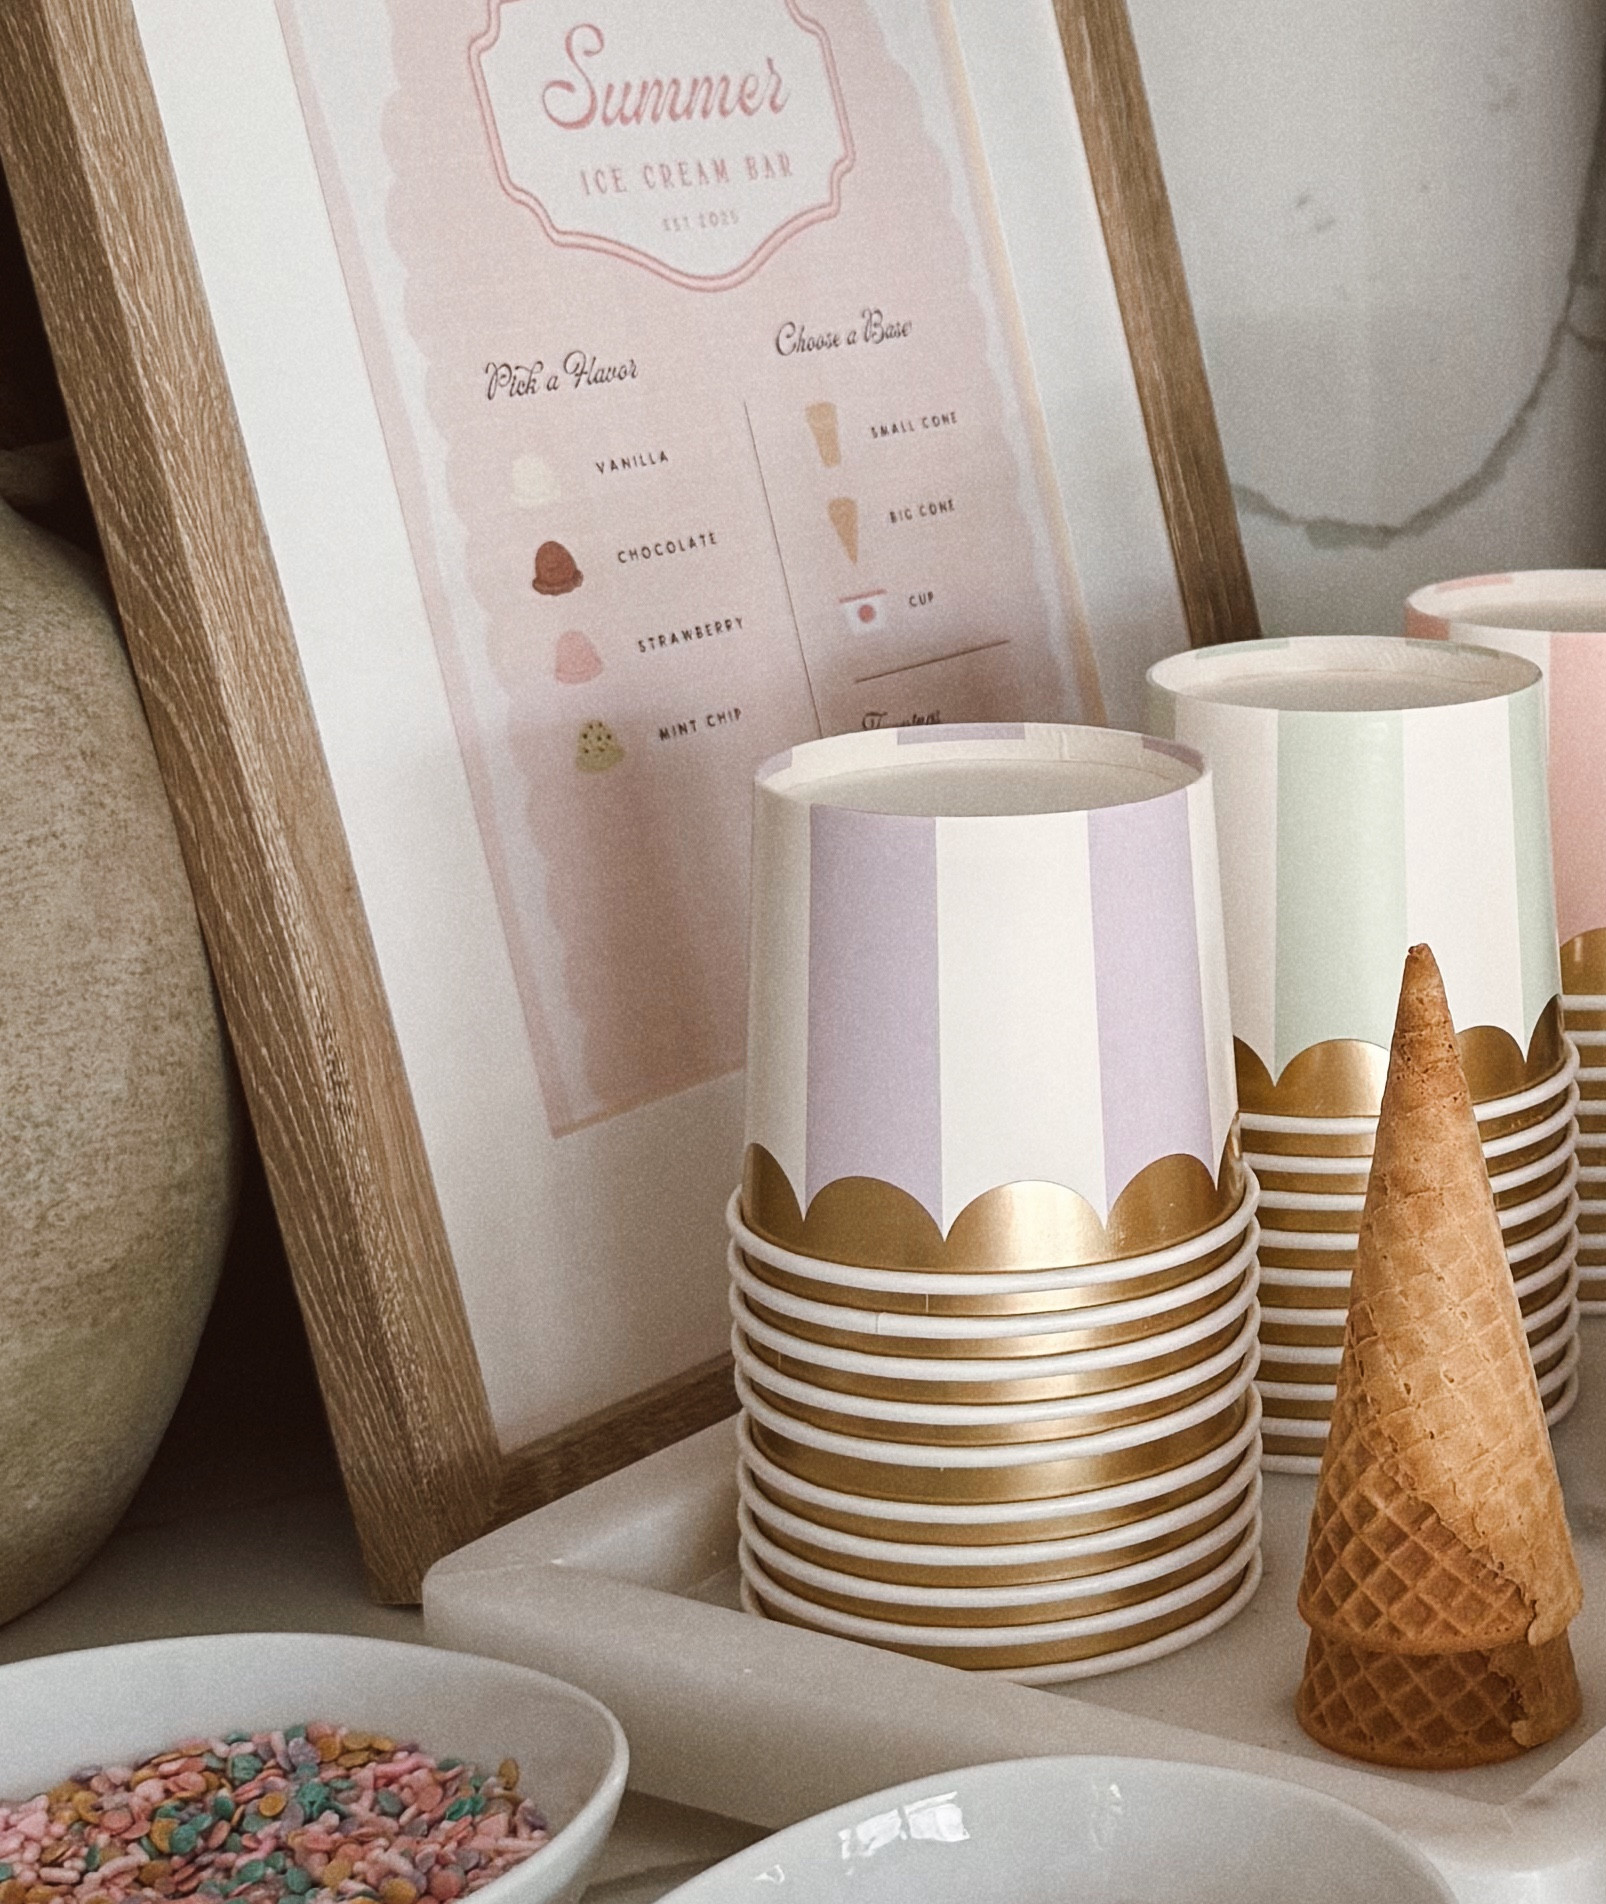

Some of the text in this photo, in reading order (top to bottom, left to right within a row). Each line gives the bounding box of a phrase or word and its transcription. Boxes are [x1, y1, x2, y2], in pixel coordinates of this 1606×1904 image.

[542, 23, 790, 130] Summer
[580, 151, 793, 195] ICE CREAM BAR
[775, 308, 913, 356] Choose a Base
[485, 350, 638, 400] Pick a Flavor
[870, 411, 957, 439] SMALL CONE
[595, 450, 669, 474] VANILLA
[889, 499, 955, 523] BIG CONE
[617, 532, 718, 563] CHOCOLATE
[908, 591, 935, 607] CUP
[638, 617, 744, 653] STRAWBERRY
[658, 707, 742, 741] MINT CHIP
